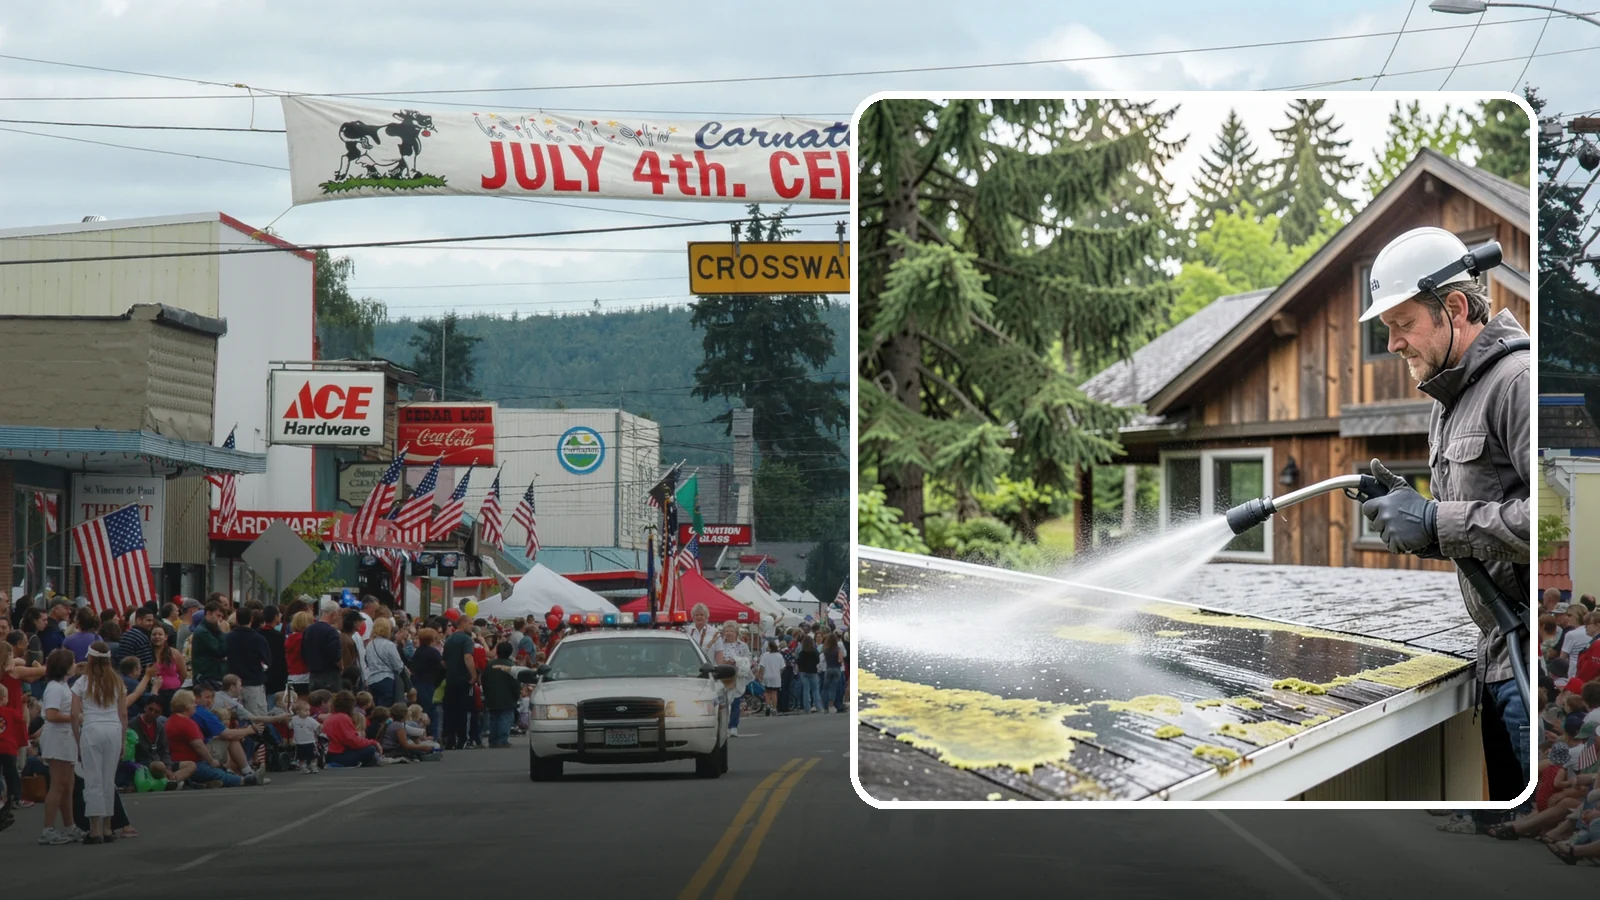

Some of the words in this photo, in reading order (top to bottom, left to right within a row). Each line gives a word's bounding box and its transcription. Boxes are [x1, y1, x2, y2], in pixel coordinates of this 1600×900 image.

[481, 141, 605, 192] JULY
[632, 150, 746, 197] 4th.
[697, 254, 850, 280] CROSSWA
[283, 380, 373, 420] ACE
[405, 409, 453, 422] CEDAR
[461, 409, 485, 422] LOG
[283, 421, 371, 436] Hardware
[96, 485, 124, 495] Vincent
[126, 486, 136, 495] de
[137, 486, 155, 495] Paul
[688, 526, 742, 535] CRNATION
[699, 535, 730, 543] GLASS
